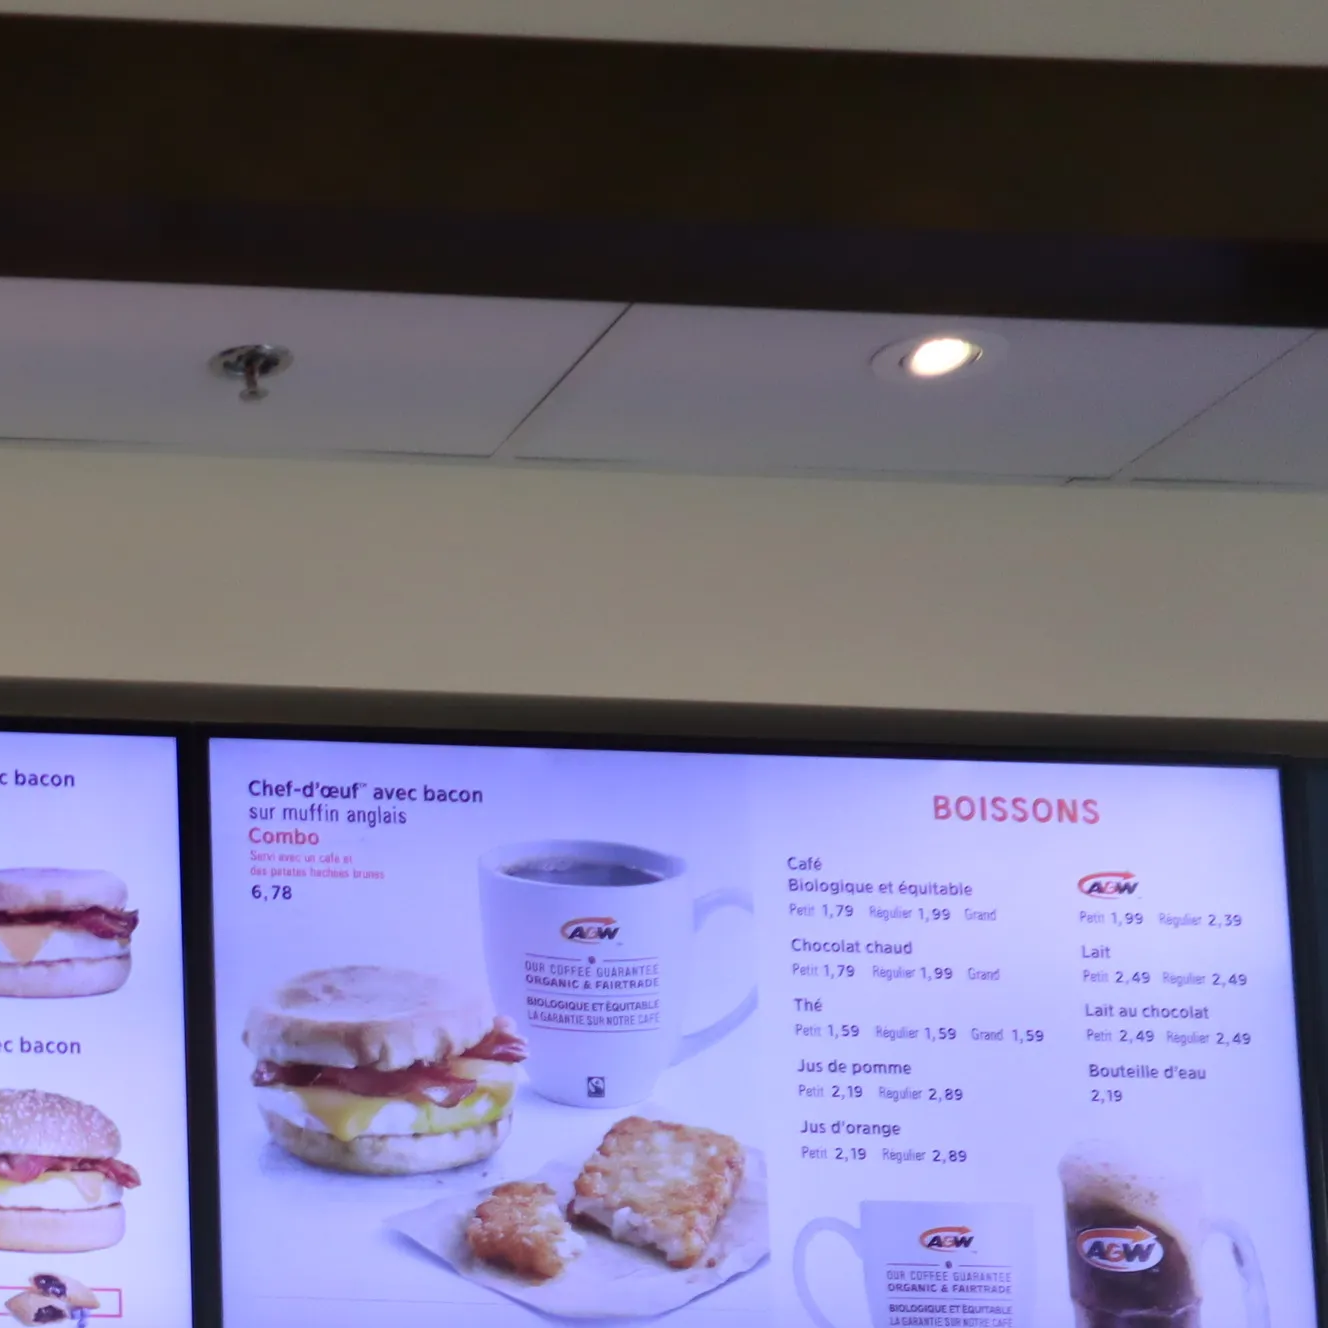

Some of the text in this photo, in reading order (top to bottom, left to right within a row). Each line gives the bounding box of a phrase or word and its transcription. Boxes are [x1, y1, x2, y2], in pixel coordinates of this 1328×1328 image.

[14, 769, 75, 788] bacon
[373, 787, 417, 801] avec
[423, 785, 483, 803] bacon
[249, 803, 407, 827] sur muffin anglais
[933, 795, 1098, 825] BOISSONS
[248, 828, 320, 845] Combo
[787, 857, 822, 871] Café
[251, 885, 292, 902] 6,78
[788, 878, 973, 897] Biologique et équitable
[791, 938, 912, 954] Chocolat chaud
[1082, 945, 1111, 959] Lait
[526, 974, 578, 989] ORGANIC
[596, 977, 659, 990] FAIRTRADE
[794, 998, 823, 1012] Thé
[1085, 1004, 1209, 1019] Lait au chocolat
[20, 1037, 81, 1055] bacon
[797, 1059, 912, 1076] Jus de pomme
[1089, 1064, 1158, 1078] Bouteille
[800, 1120, 901, 1137] Jus d'orange
